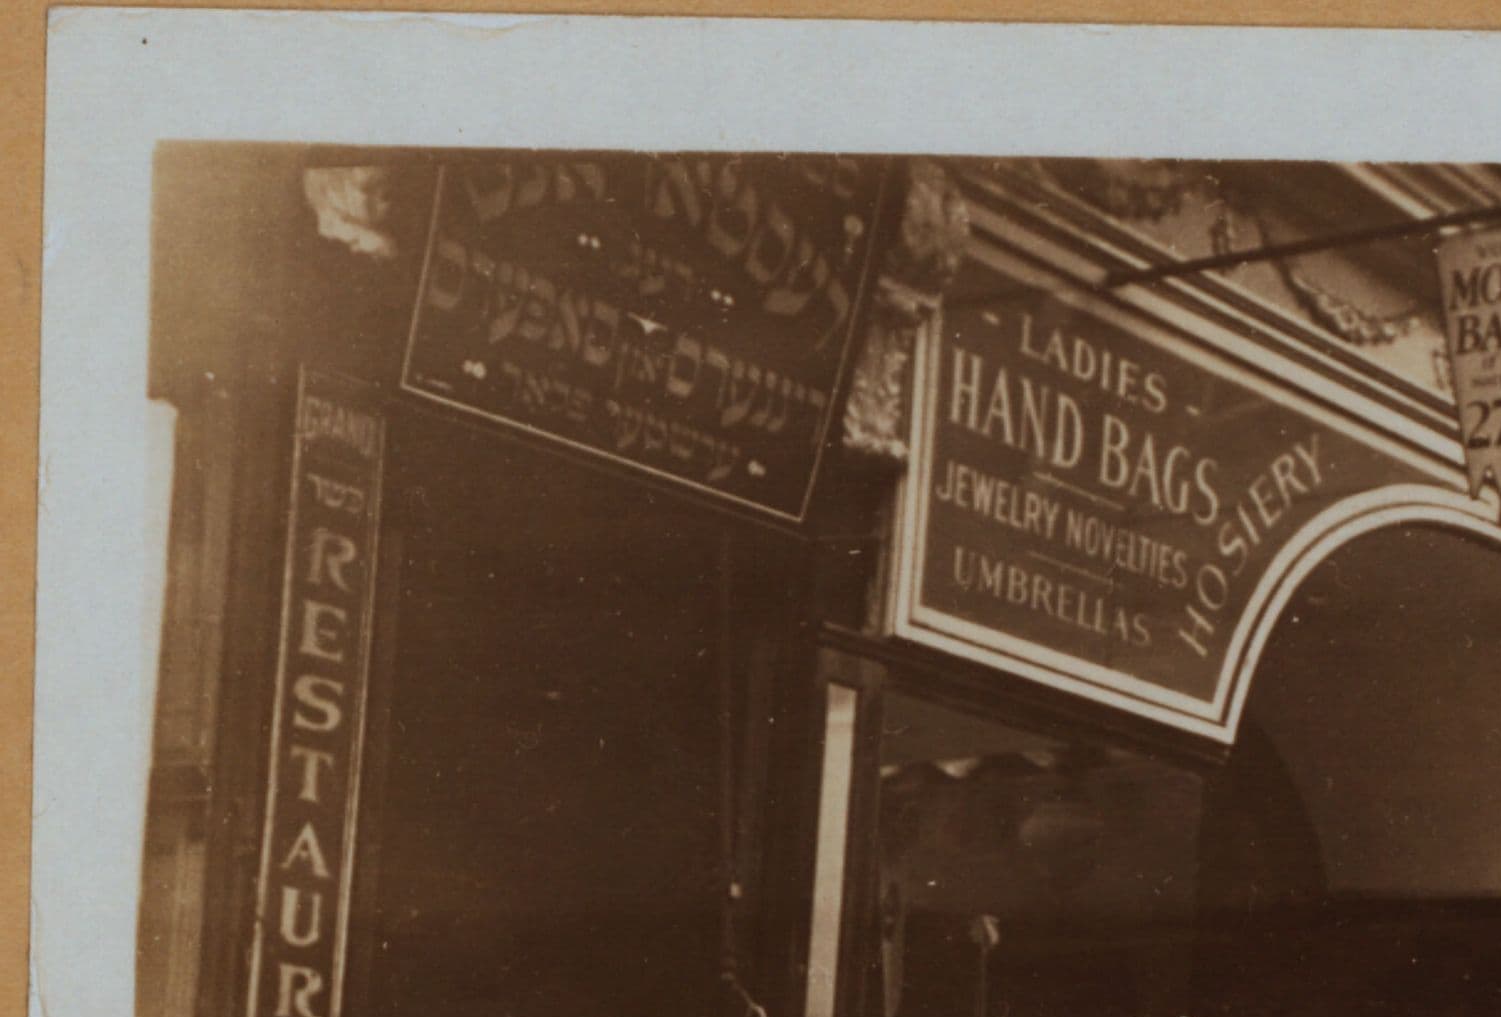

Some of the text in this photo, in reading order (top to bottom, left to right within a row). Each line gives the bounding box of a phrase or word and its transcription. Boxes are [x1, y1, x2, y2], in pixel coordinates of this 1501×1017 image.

[1019, 313, 1168, 414] LADIES
[950, 347, 1220, 526] HAND BAGS
[936, 461, 1190, 590] JEWELRY NOVELTIES
[1178, 432, 1323, 658] HOSIERY
[952, 547, 1152, 648] UMBRELLAS
